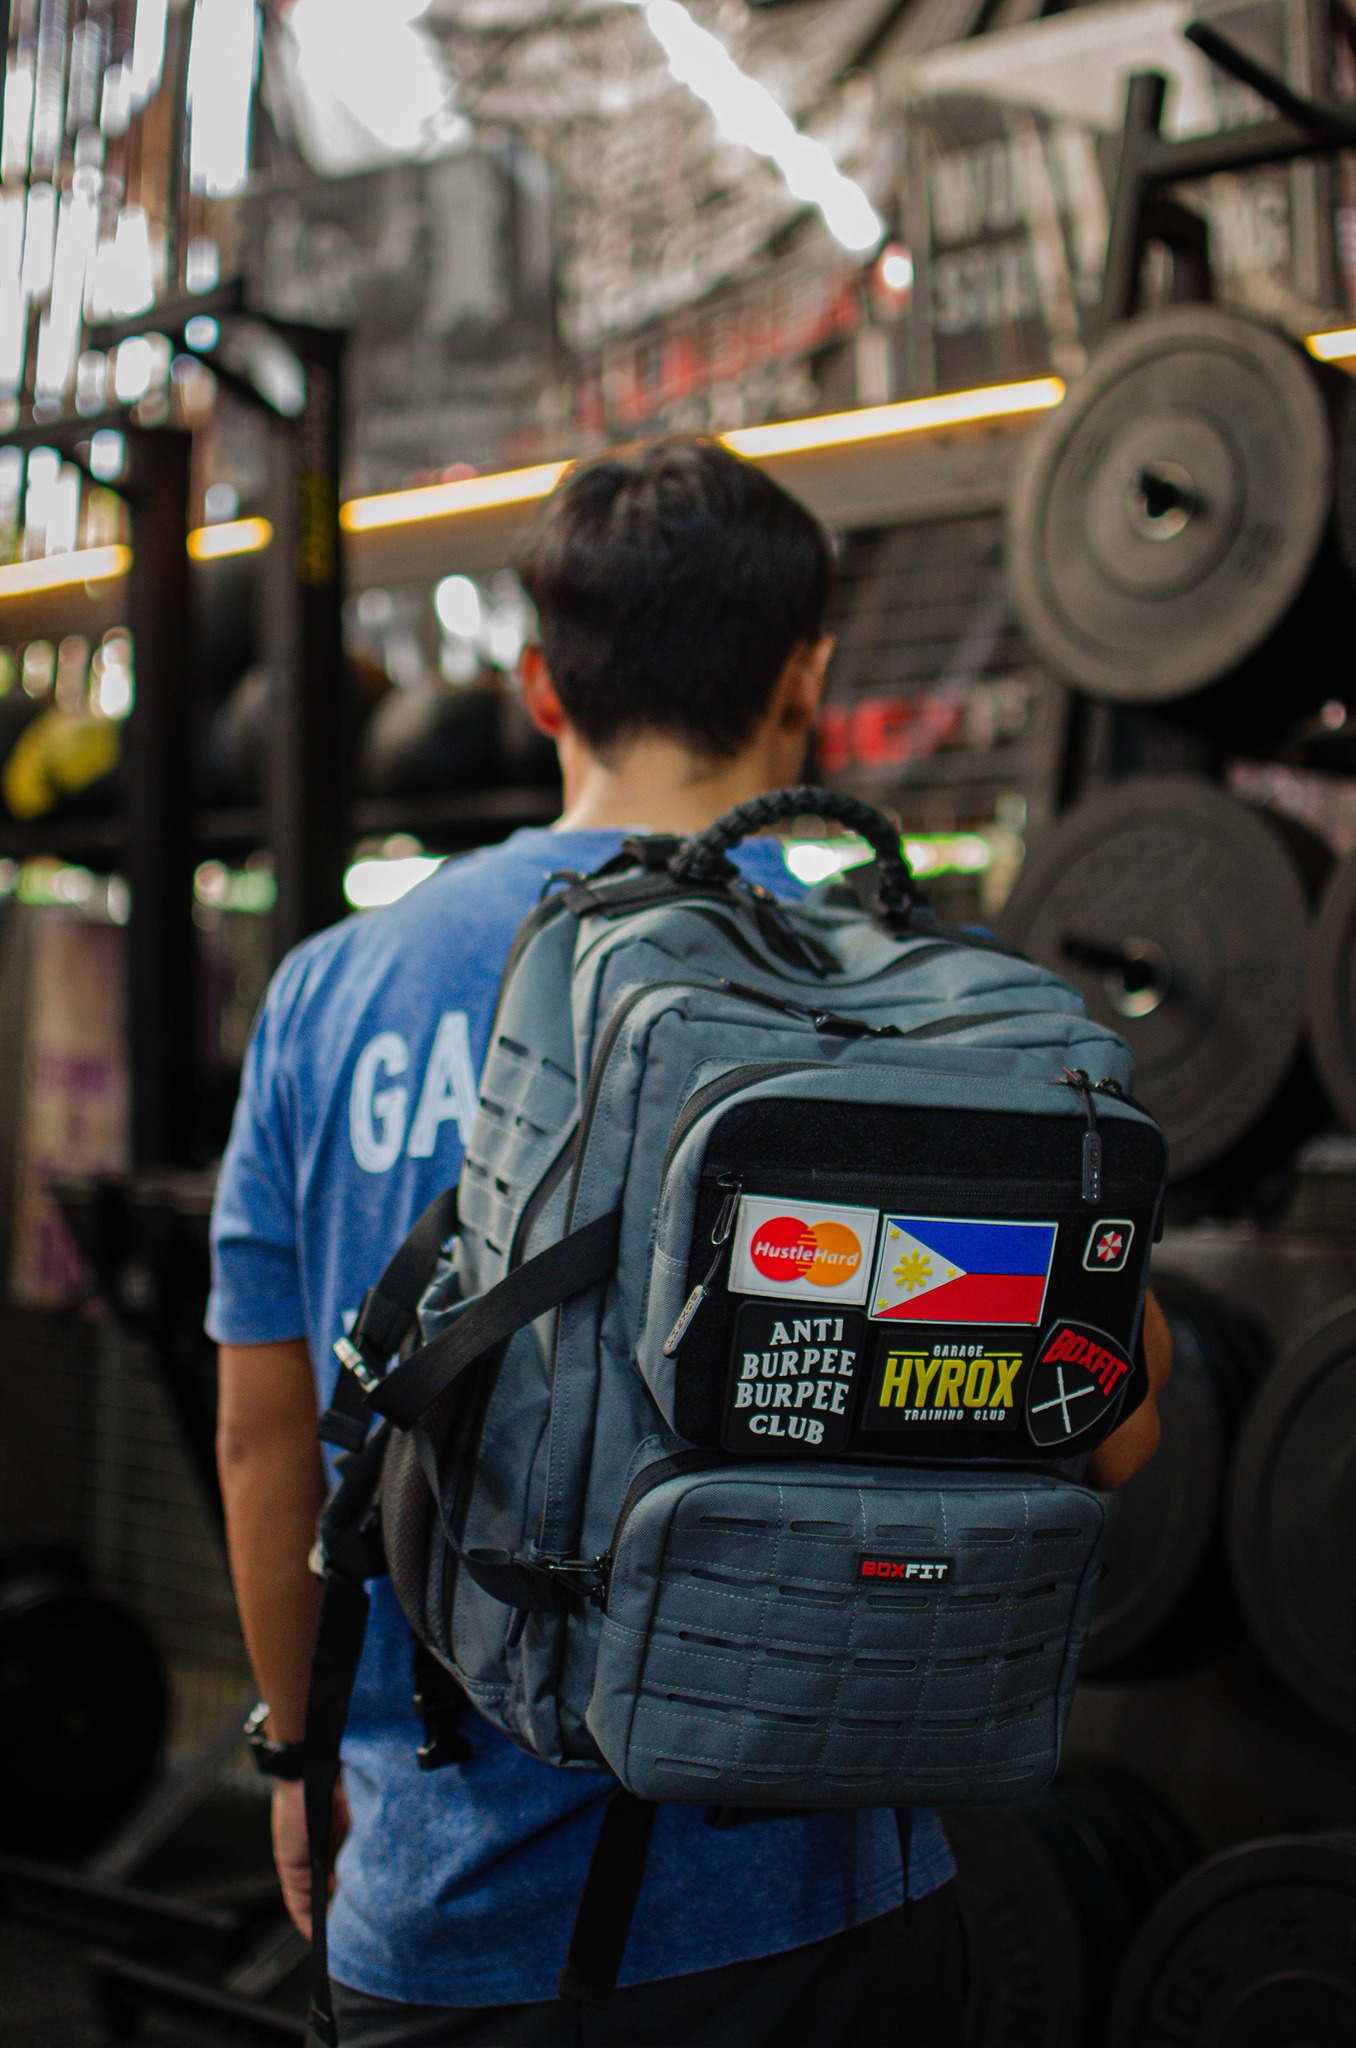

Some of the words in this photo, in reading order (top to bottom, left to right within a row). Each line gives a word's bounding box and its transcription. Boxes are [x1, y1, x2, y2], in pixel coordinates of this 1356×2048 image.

[754, 1241, 859, 1268] HustleHard
[769, 1318, 844, 1346] ANTI
[741, 1348, 856, 1380] BURPEE
[933, 1344, 984, 1358] GARAGE
[1042, 1328, 1128, 1397] BOXFIT
[879, 1358, 1023, 1408] HYROX
[734, 1380, 850, 1416] BURPEE
[749, 1414, 825, 1445] CLUB
[904, 1410, 964, 1421] TRAINING
[973, 1410, 1006, 1421] CLUB
[861, 1561, 948, 1579] BOXFIT
